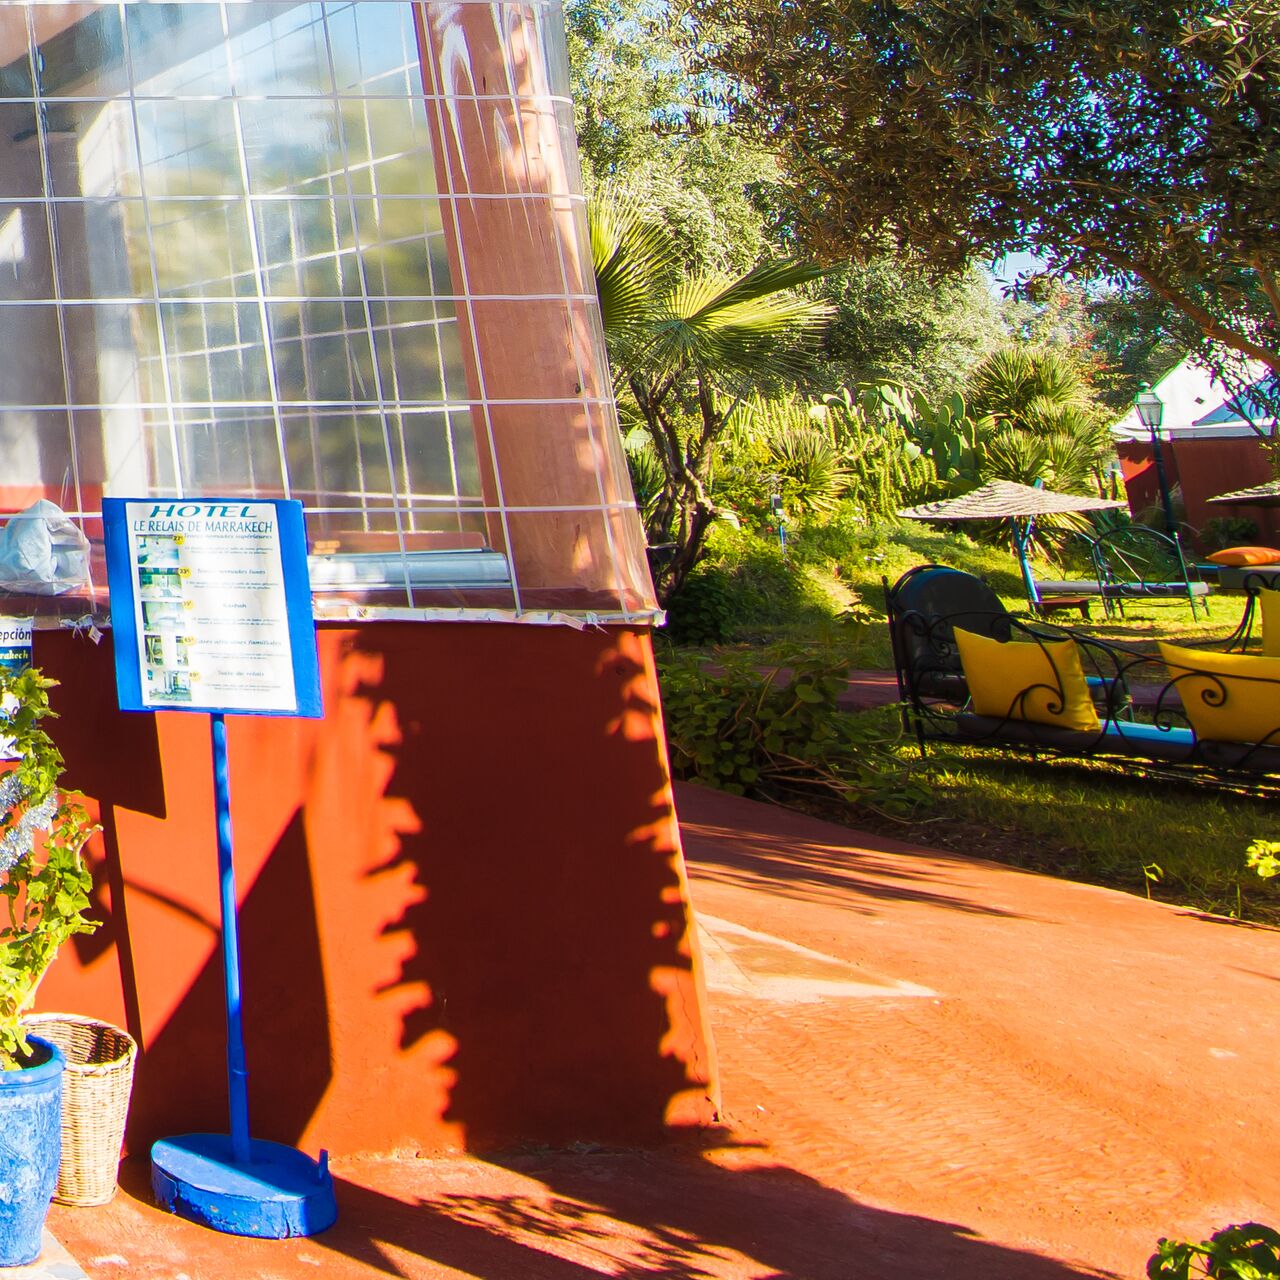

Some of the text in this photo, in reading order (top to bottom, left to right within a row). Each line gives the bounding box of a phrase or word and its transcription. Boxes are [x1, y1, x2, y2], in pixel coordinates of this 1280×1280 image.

[150, 504, 257, 518] HOTEL
[133, 520, 273, 533] LE RELAIS DE MARRAKECH
